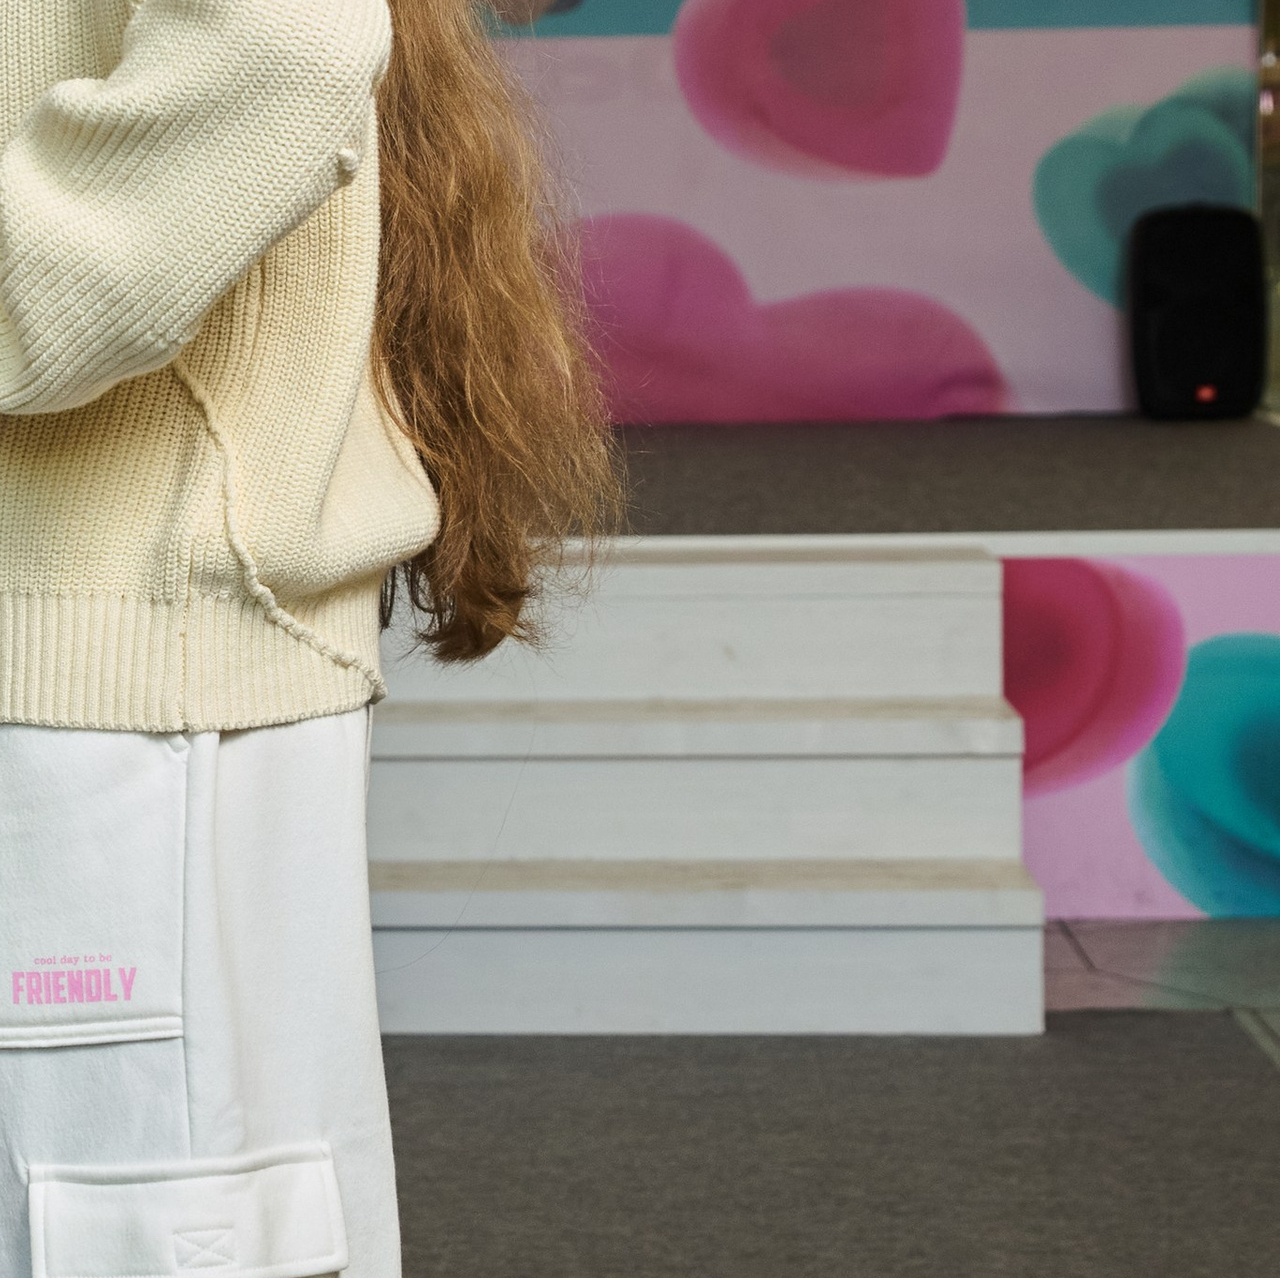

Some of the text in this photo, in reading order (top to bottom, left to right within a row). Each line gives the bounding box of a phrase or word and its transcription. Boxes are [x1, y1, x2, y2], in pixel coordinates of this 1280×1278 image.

[33, 952, 113, 966] cool day to be
[11, 966, 138, 1005] FRIENDLY
